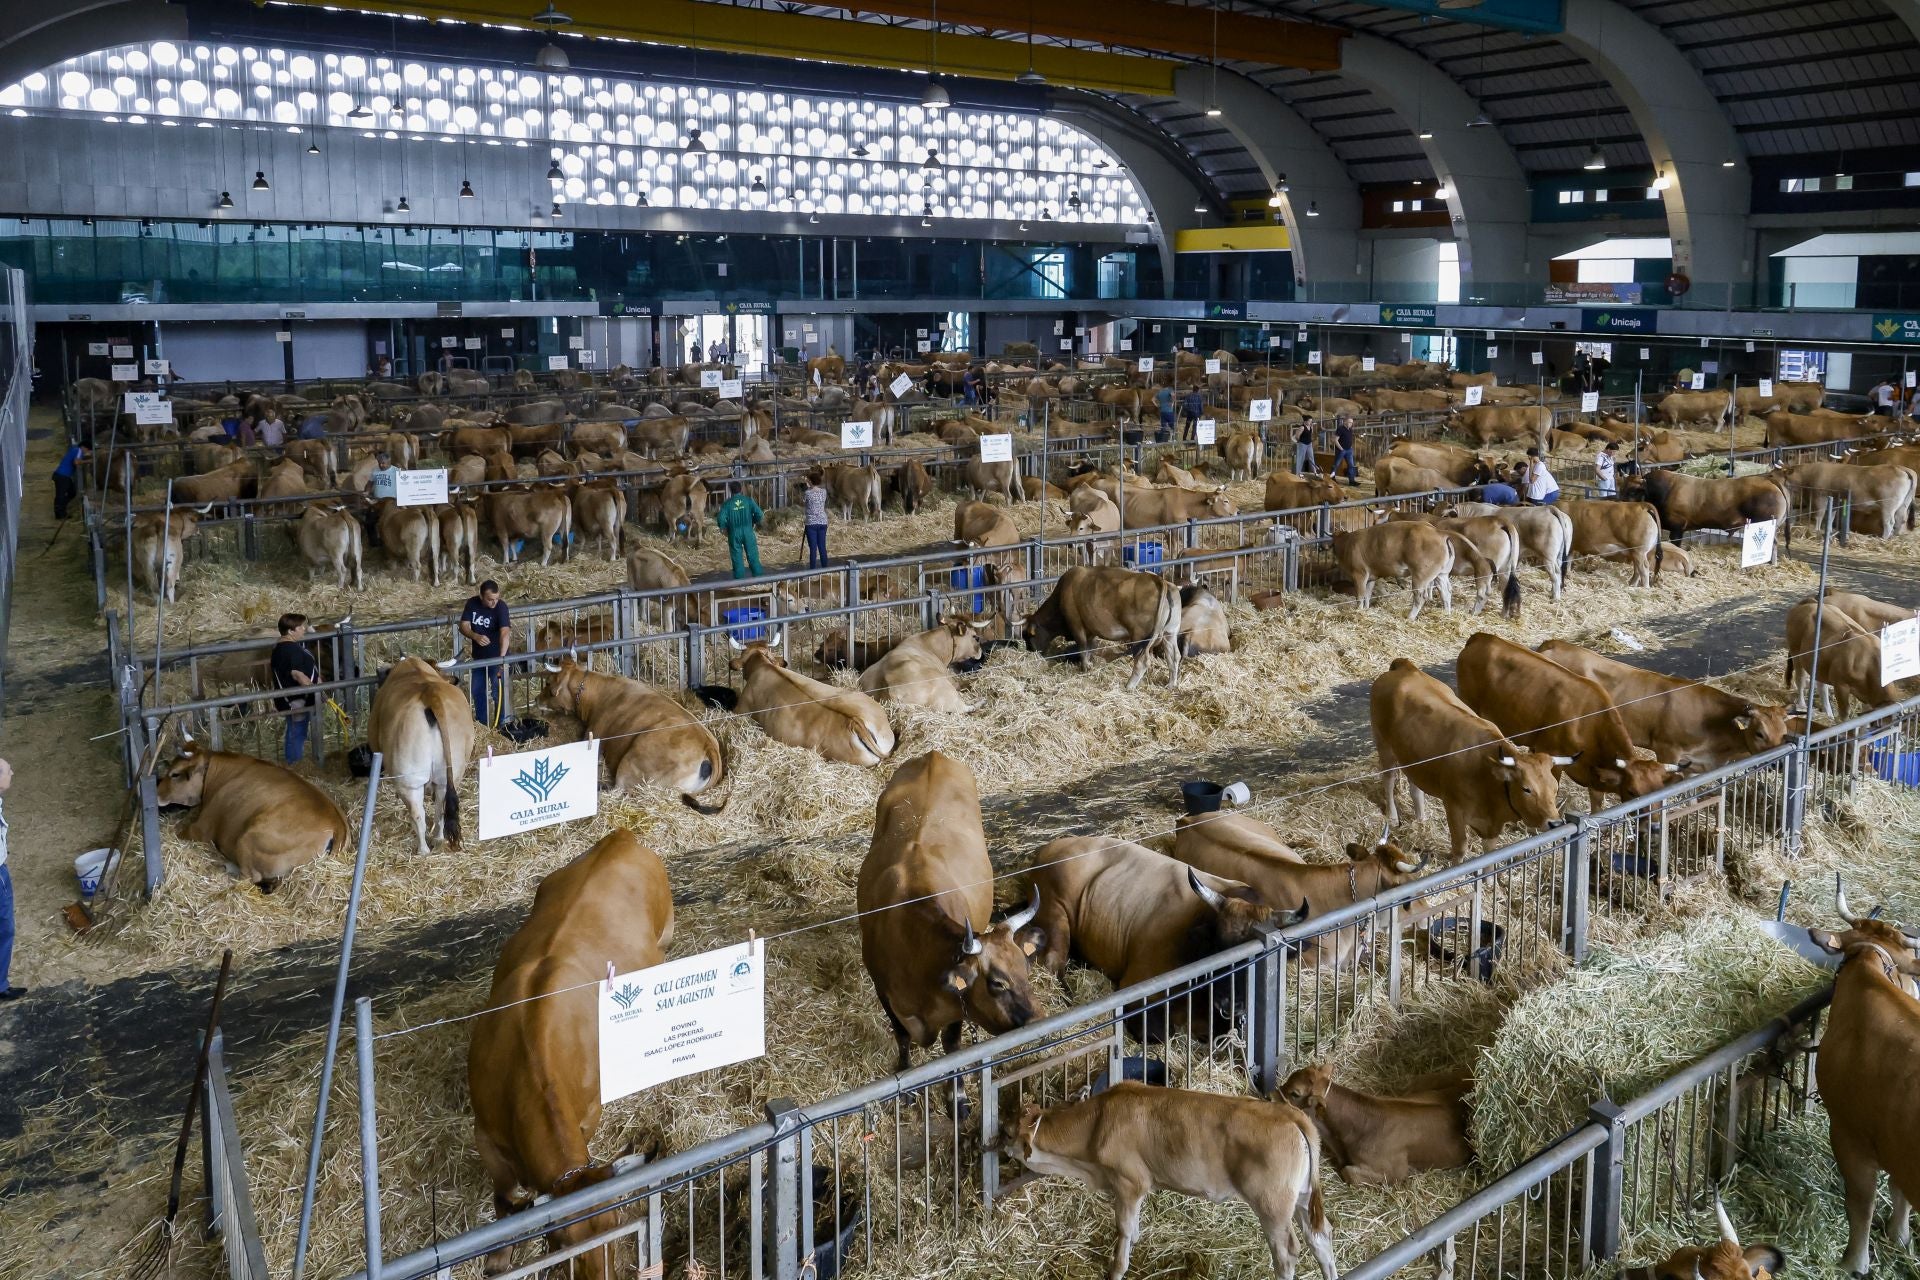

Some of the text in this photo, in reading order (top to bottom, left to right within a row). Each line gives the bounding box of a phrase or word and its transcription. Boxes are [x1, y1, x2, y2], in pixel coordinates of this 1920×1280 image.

[626, 306, 650, 314] Unicaja
[1221, 308, 1238, 316] Unicaja
[1611, 318, 1641, 328] Unicaja
[1904, 320, 1920, 329] CA
[472, 611, 491, 628] Lee
[510, 801, 570, 820] CAJA RURAL
[653, 968, 718, 996] CXLI CERTAMEN
[655, 986, 715, 1012] SAN AGUSTÍN
[671, 1020, 697, 1032] BOVINO
[663, 1027, 704, 1043] LAS PIKERAS
[644, 1047, 663, 1058] ISAAC
[672, 1053, 696, 1064] PRAVIA
